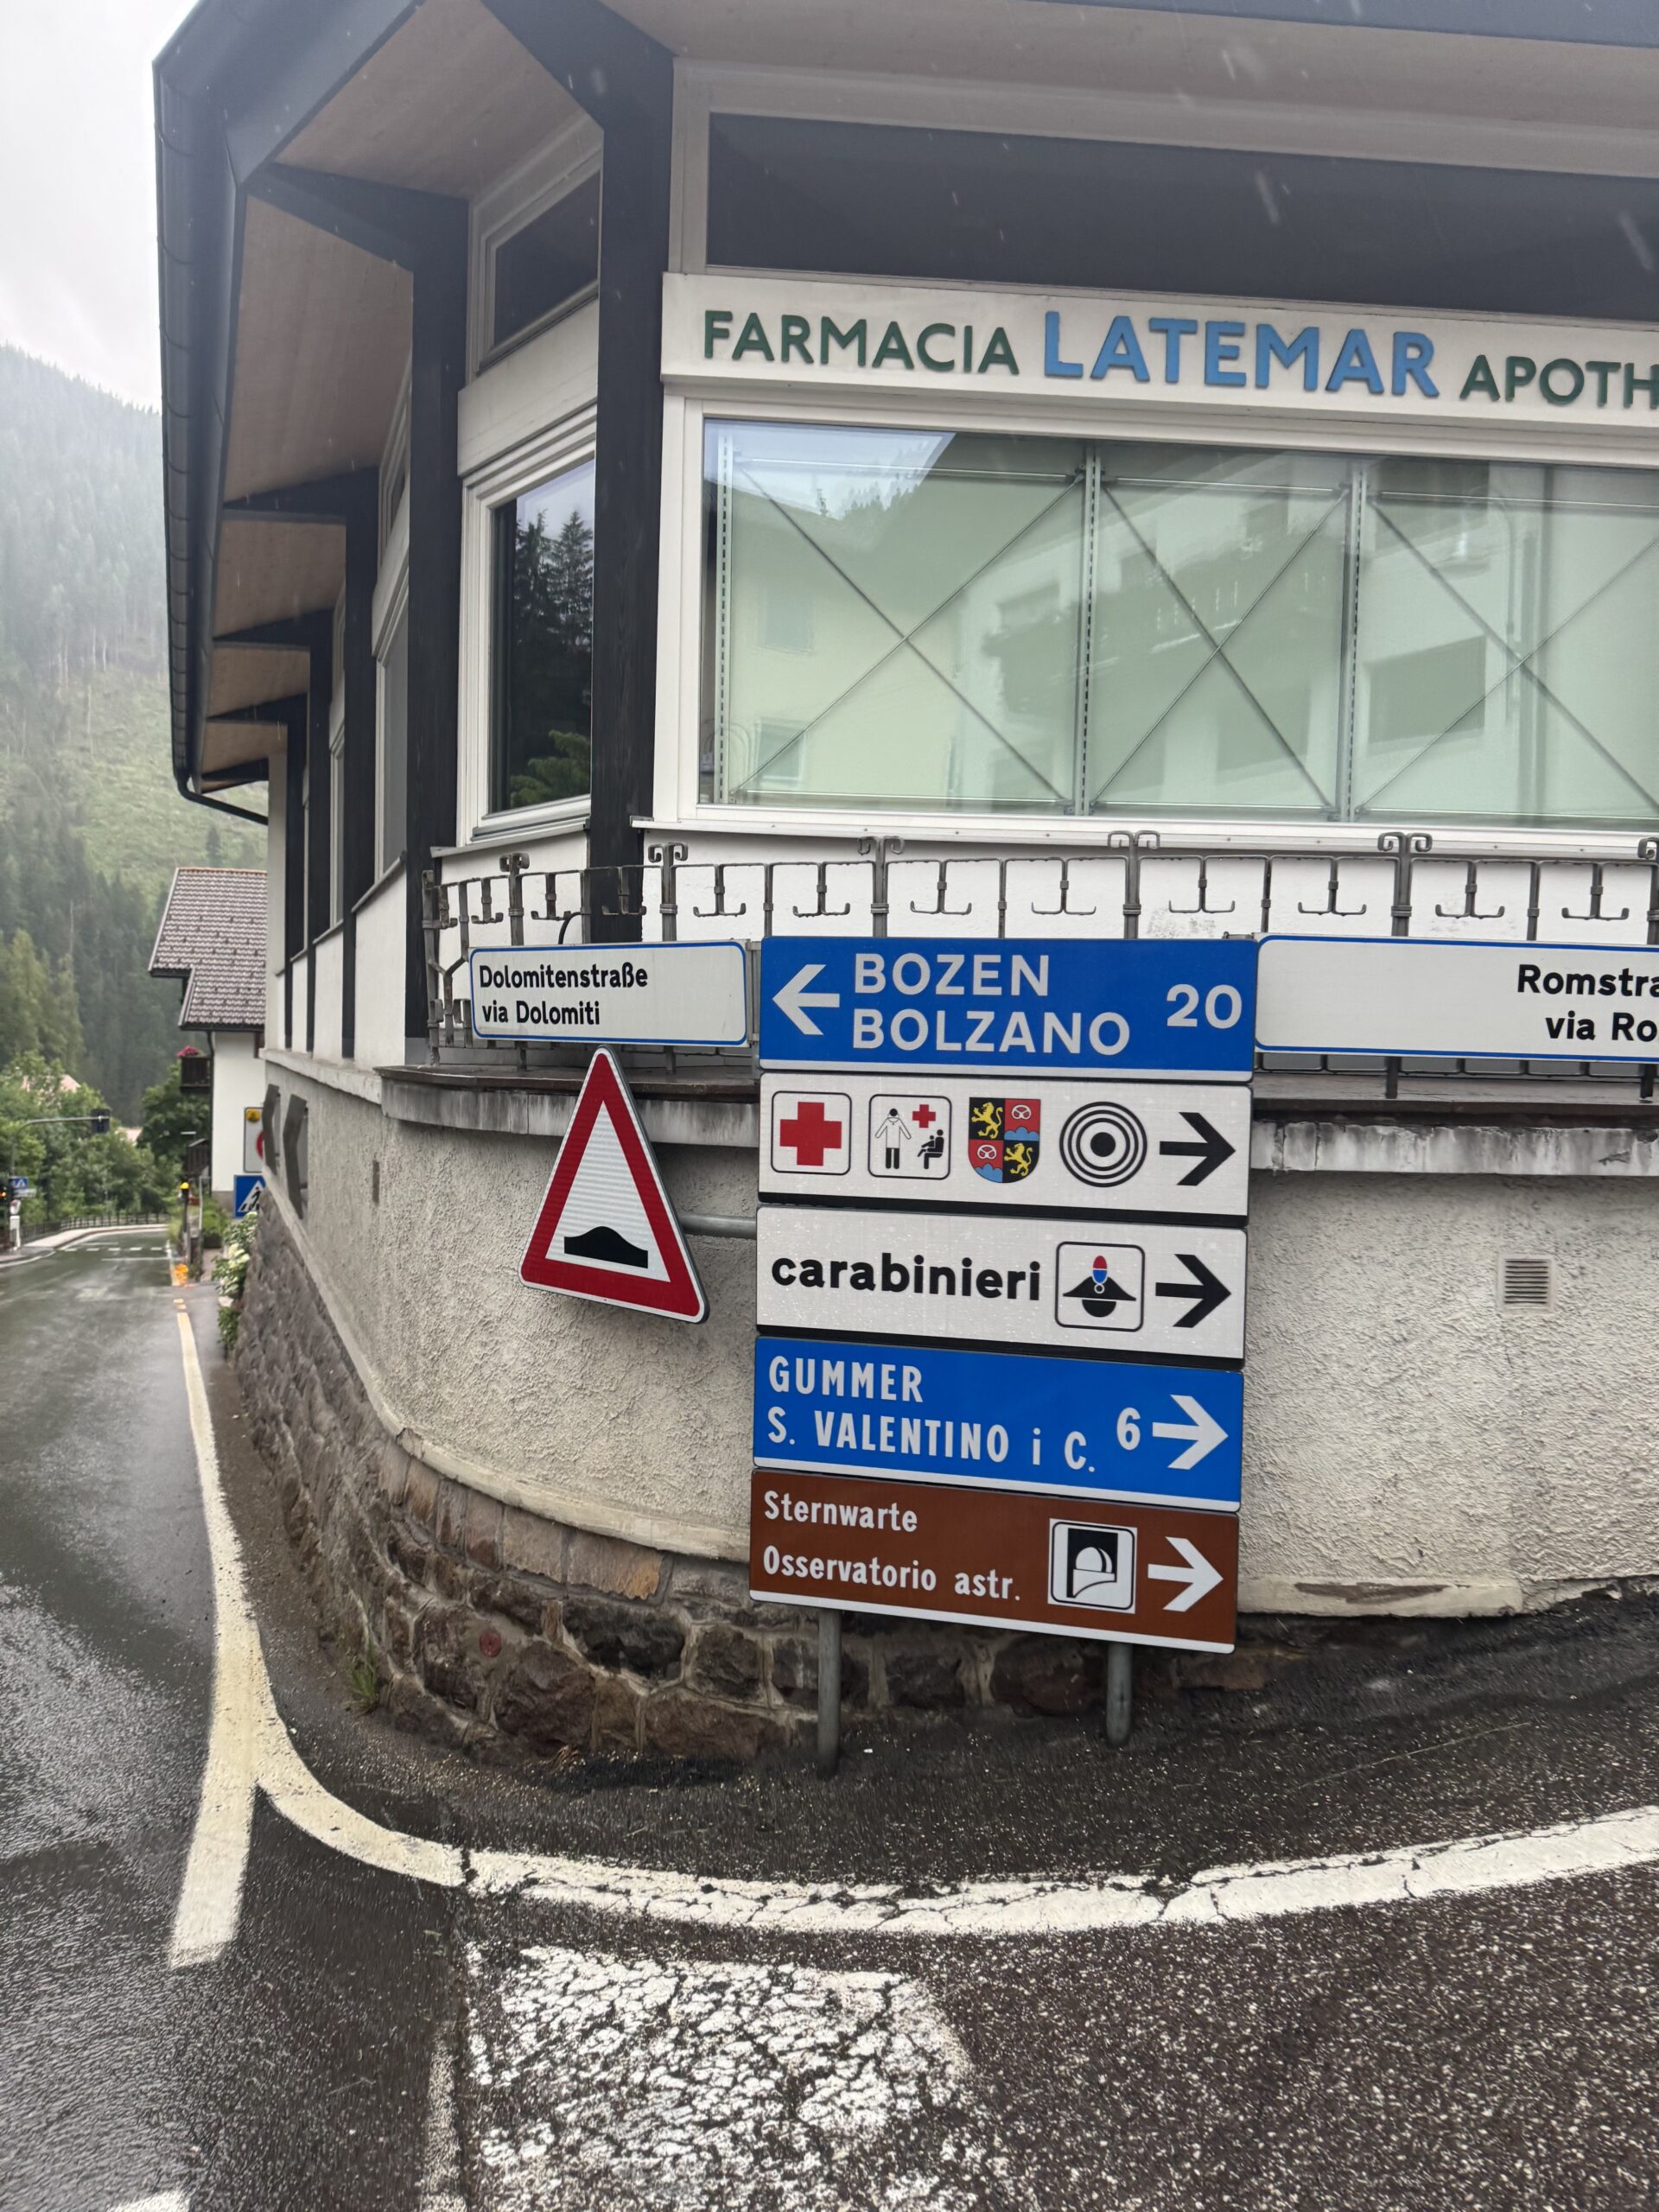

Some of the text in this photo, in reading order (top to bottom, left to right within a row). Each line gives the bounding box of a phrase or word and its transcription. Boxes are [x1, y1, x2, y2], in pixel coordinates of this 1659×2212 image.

[704, 310, 1659, 410] FARMACIA LATEMAR APOTH
[480, 962, 648, 989] Dolomitenstraße
[855, 953, 1049, 996] BOZEN
[482, 1000, 601, 1026] via Dolomiti
[1166, 983, 1243, 1029] 20
[1545, 1010, 1596, 1040] via
[852, 1008, 1130, 1056] BOLZANO
[771, 1252, 1041, 1300] carabinieri
[768, 1355, 923, 1402] GUMMER
[767, 1406, 1096, 1472] S. VALENTINO i C.
[1116, 1408, 1141, 1451] 6
[764, 1491, 918, 1533] Sternwarte
[762, 1545, 1021, 1601] Osservatorio astr.
